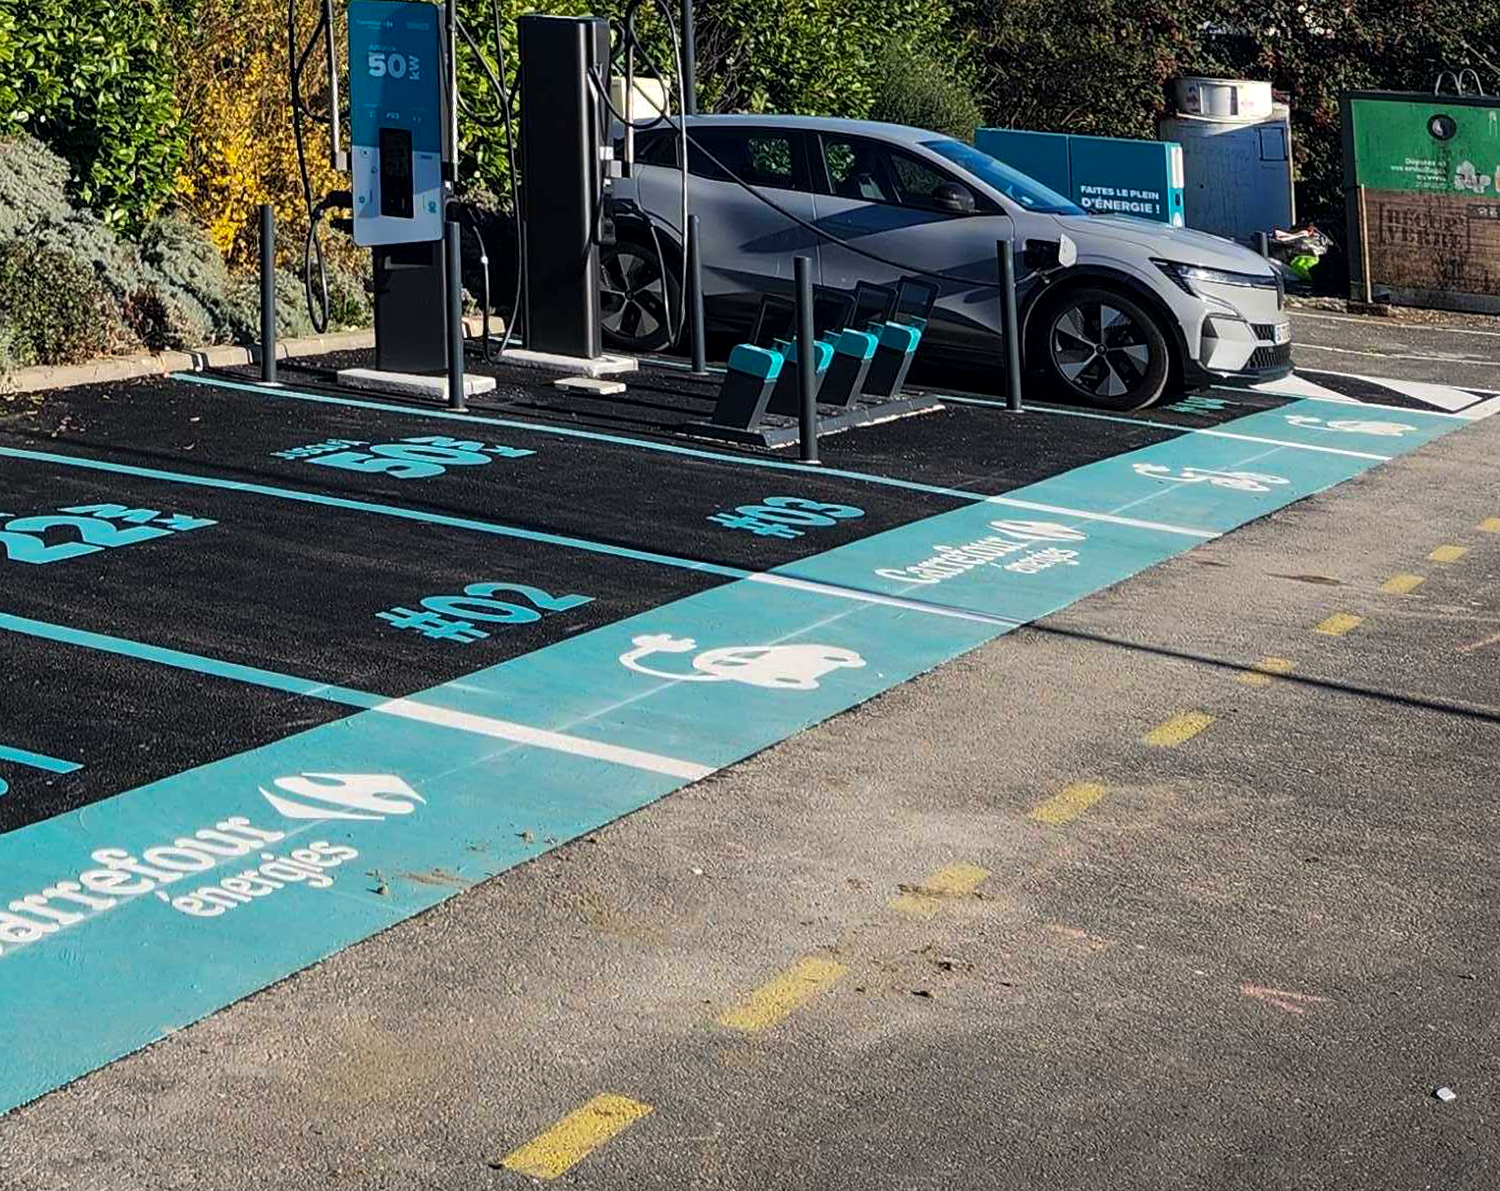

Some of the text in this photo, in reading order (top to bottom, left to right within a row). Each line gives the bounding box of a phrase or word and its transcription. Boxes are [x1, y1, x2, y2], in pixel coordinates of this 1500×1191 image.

[368, 51, 406, 79] 50
[1080, 185, 1160, 200] FAITES LE PLEIN
[1081, 196, 1153, 214] D'ÉNERGIE
[303, 443, 493, 479] 50
[706, 496, 866, 539] #03
[874, 535, 1029, 584] Carrefour
[375, 581, 597, 644] #02
[157, 840, 359, 917] énergies
